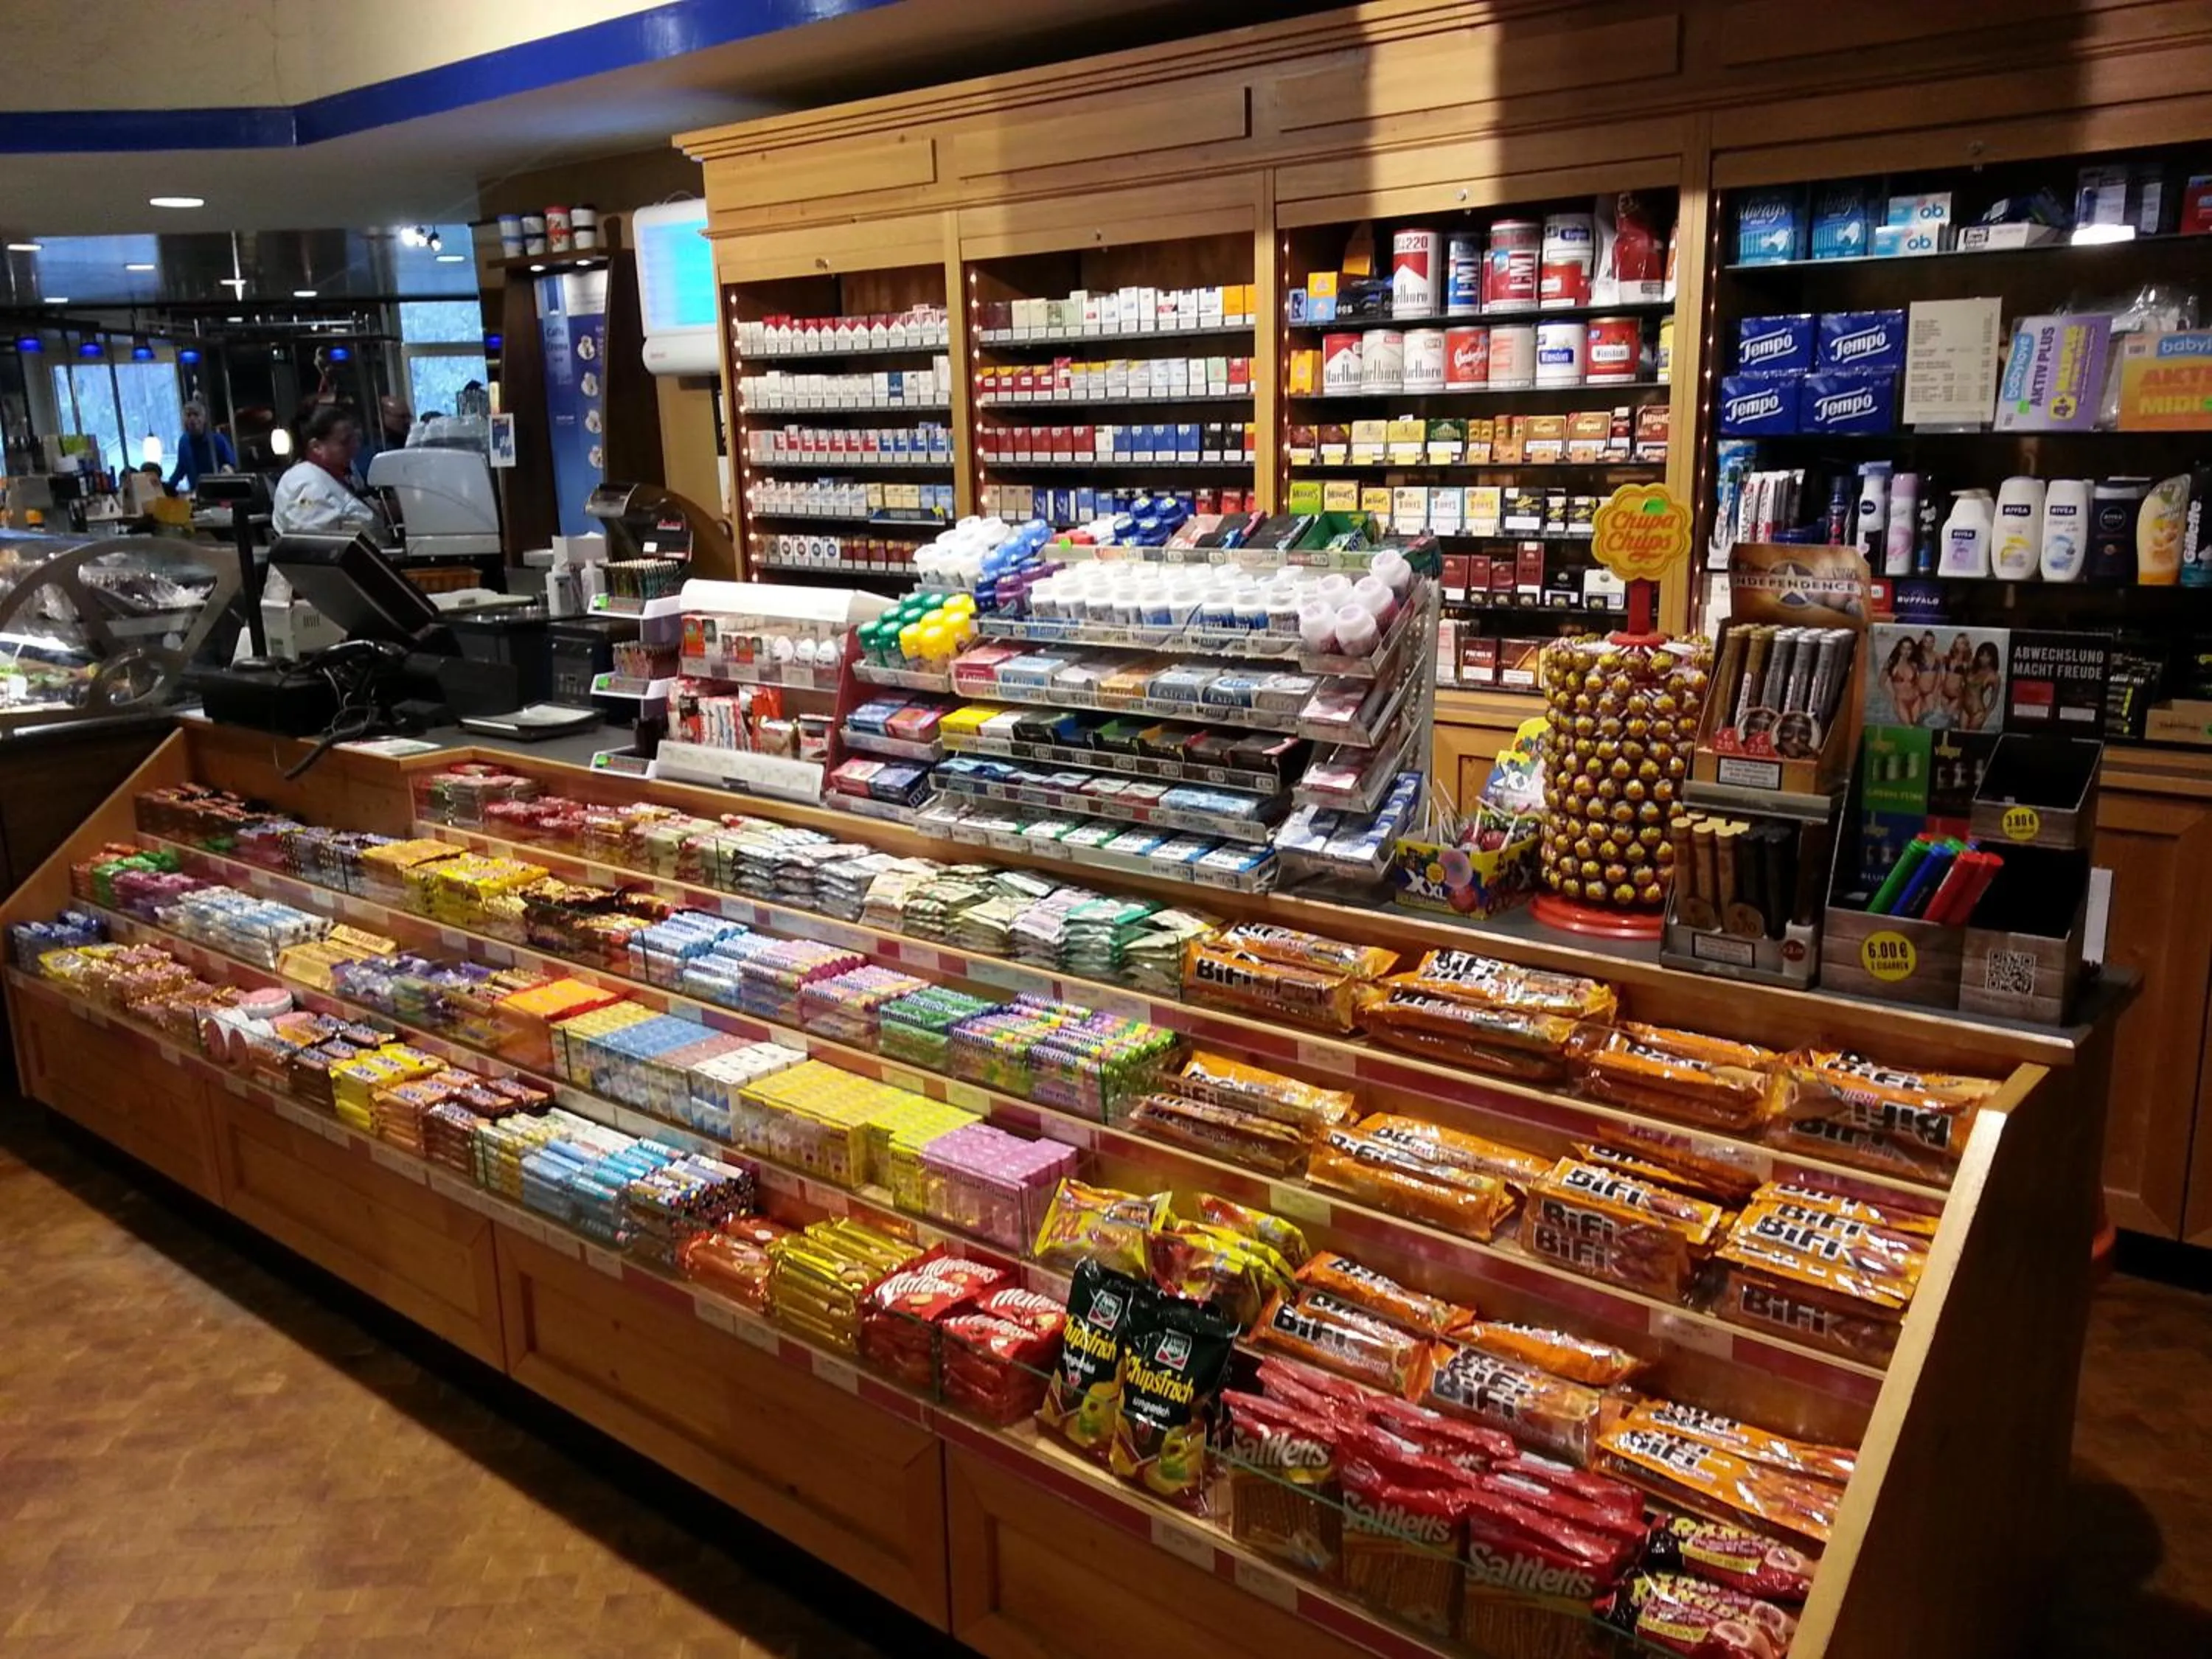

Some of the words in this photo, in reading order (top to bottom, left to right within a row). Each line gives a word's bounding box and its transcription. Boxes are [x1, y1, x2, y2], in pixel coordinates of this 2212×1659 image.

[1739, 328, 1798, 364] Tempo
[1829, 325, 1891, 364] Tempo
[2006, 335, 2031, 398] babylove
[2028, 364, 2048, 407] AKTIV
[2039, 327, 2055, 362] PLUS
[1725, 389, 1784, 424] Tempo
[1815, 387, 1879, 424] Tempo
[1611, 510, 1677, 535] Chupa
[2004, 506, 2029, 515] NIVEA
[2050, 506, 2075, 515] NIVEA
[1607, 530, 1672, 563] Chups
[1736, 576, 1857, 591] NDEPENDENCE
[1896, 596, 1940, 605] BUFFALO
[2013, 662, 2053, 677] MACHT
[2056, 664, 2102, 680] FREUDE
[2014, 646, 2104, 664] ABWECHSLUNG
[1404, 868, 1447, 900] XXL
[1867, 940, 1897, 959] 6.00
[1562, 1167, 1644, 1208] BiFi
[1754, 1215, 1842, 1260] BiFi
[1124, 1348, 1194, 1405] Chipsfrisch
[1232, 1427, 1330, 1470] Saltletts
[1341, 1489, 1452, 1544] Saltletts
[1467, 1542, 1599, 1600] Saltletts
